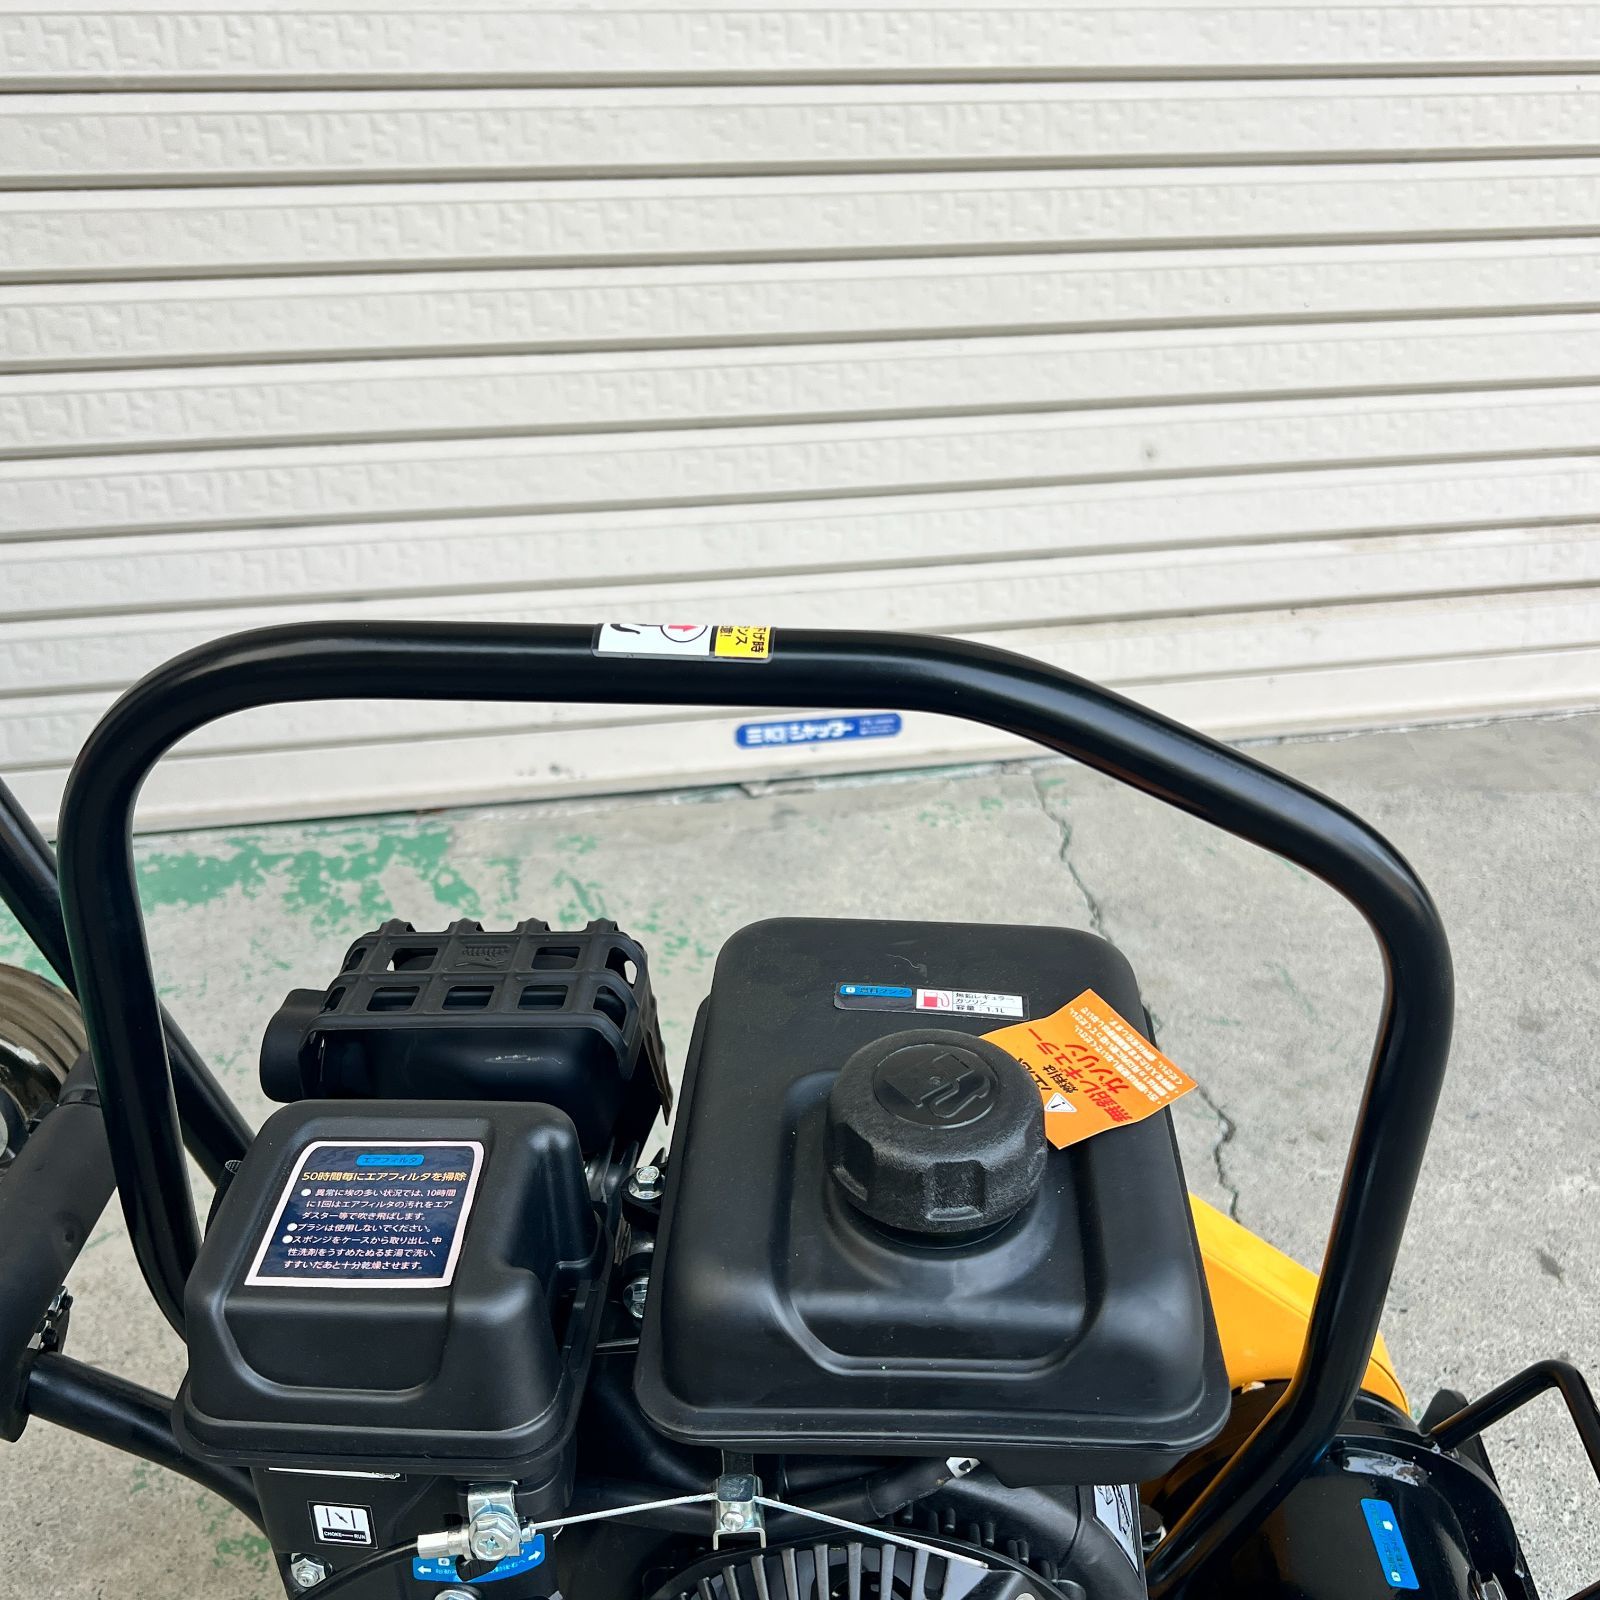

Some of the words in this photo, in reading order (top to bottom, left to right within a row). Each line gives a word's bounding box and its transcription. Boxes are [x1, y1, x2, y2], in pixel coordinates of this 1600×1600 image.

[736, 625, 750, 645] ンス
[1028, 1028, 1133, 1122] 無鉛レギュラー
[1042, 1064, 1079, 1094] 燃料は
[1064, 1043, 1130, 1095] ガソリン
[301, 1171, 468, 1182] 50時間毎にエアフィルタを掃除
